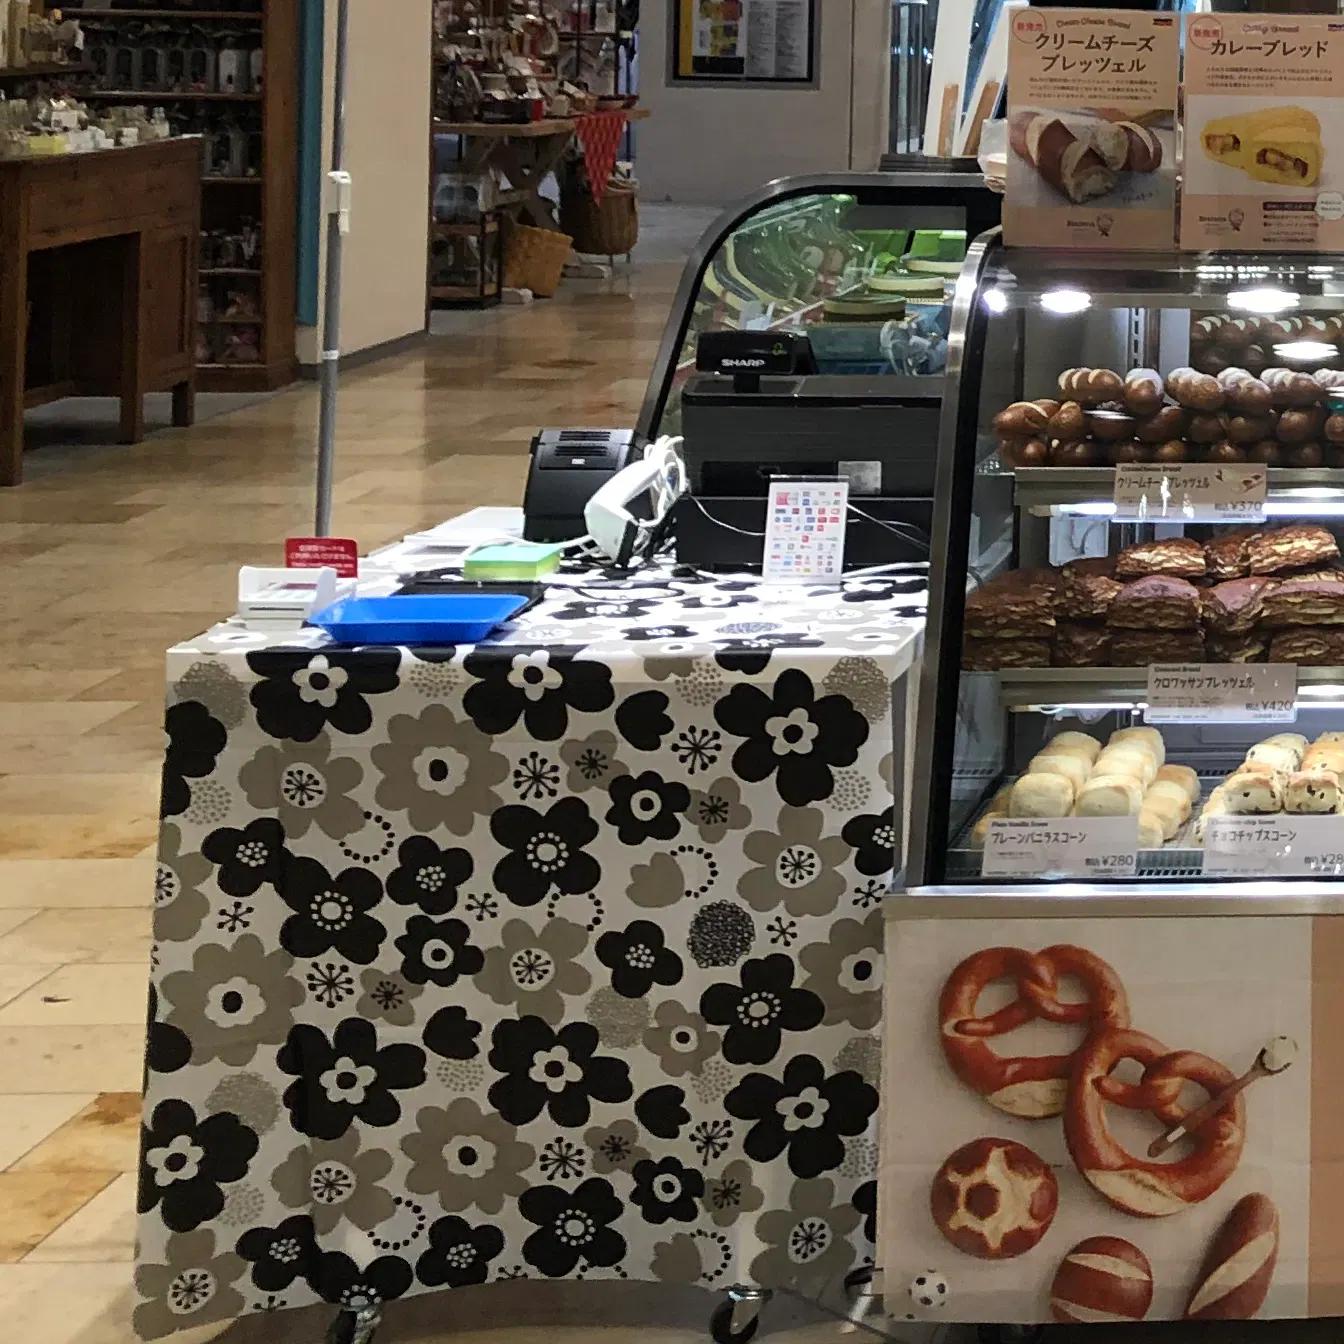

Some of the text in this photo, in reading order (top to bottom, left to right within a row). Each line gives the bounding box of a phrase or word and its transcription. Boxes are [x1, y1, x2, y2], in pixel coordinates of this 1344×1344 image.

[1035, 32, 1157, 54] クリームチーズ
[1210, 39, 1330, 59] カレーブレッド
[1041, 55, 1147, 74] ブレッツェル
[721, 358, 766, 368] SHARP
[1117, 475, 1210, 489] クリームチーブレッツェル
[1261, 700, 1292, 712] ¥420
[1211, 830, 1297, 842] チョコチップスコーン
[1101, 854, 1133, 867] ¥280
